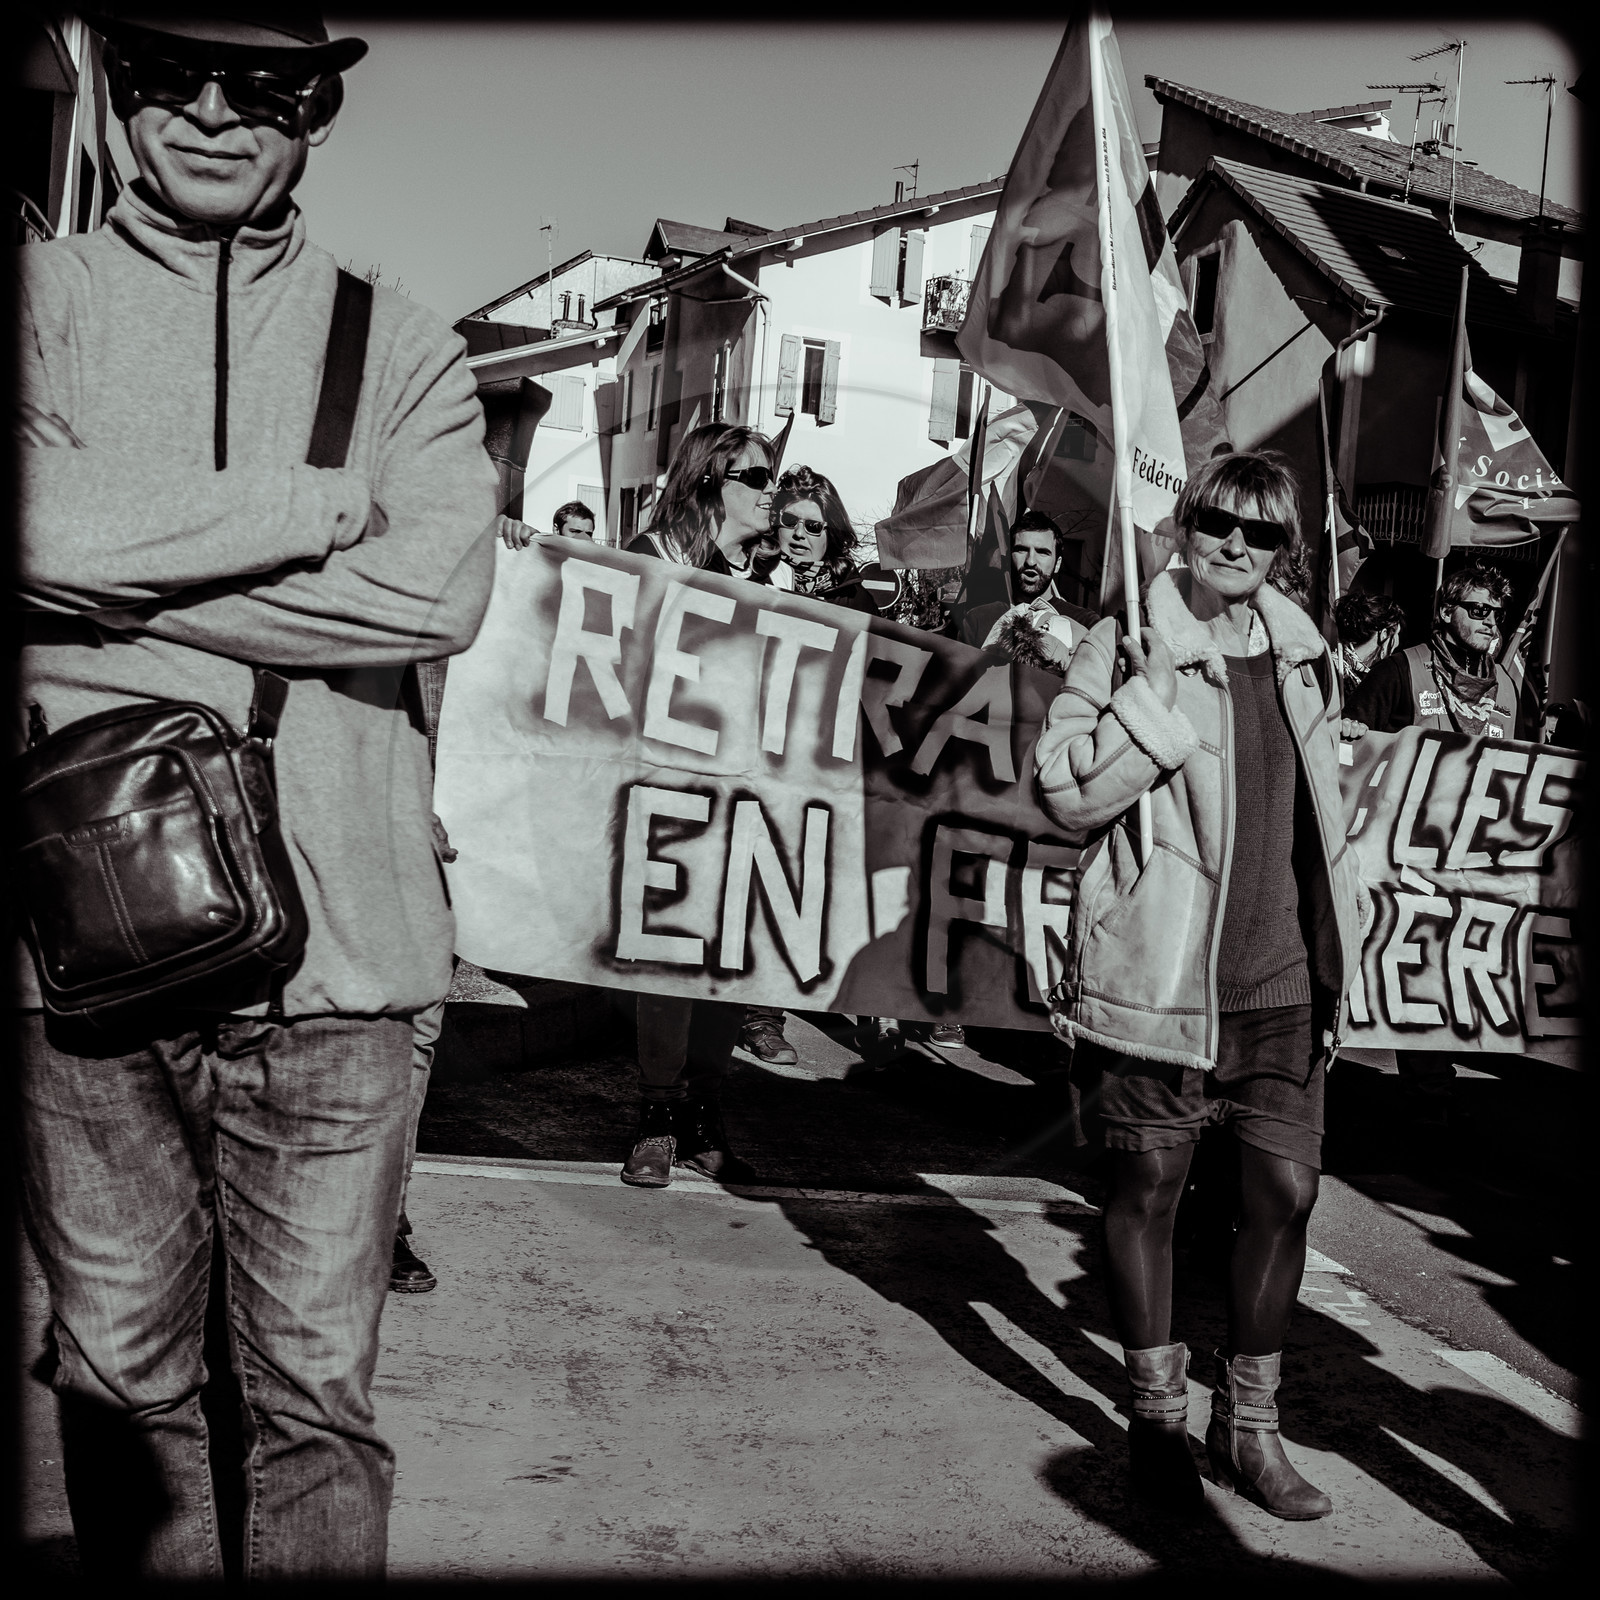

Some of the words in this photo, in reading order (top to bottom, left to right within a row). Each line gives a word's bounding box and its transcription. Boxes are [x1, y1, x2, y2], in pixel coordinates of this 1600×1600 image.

[1132, 446, 1183, 495] Fédéra
[1471, 455, 1563, 490] Socia
[543, 556, 1017, 784] RETRA
[1393, 738, 1577, 870] LES
[615, 784, 829, 983] EN
